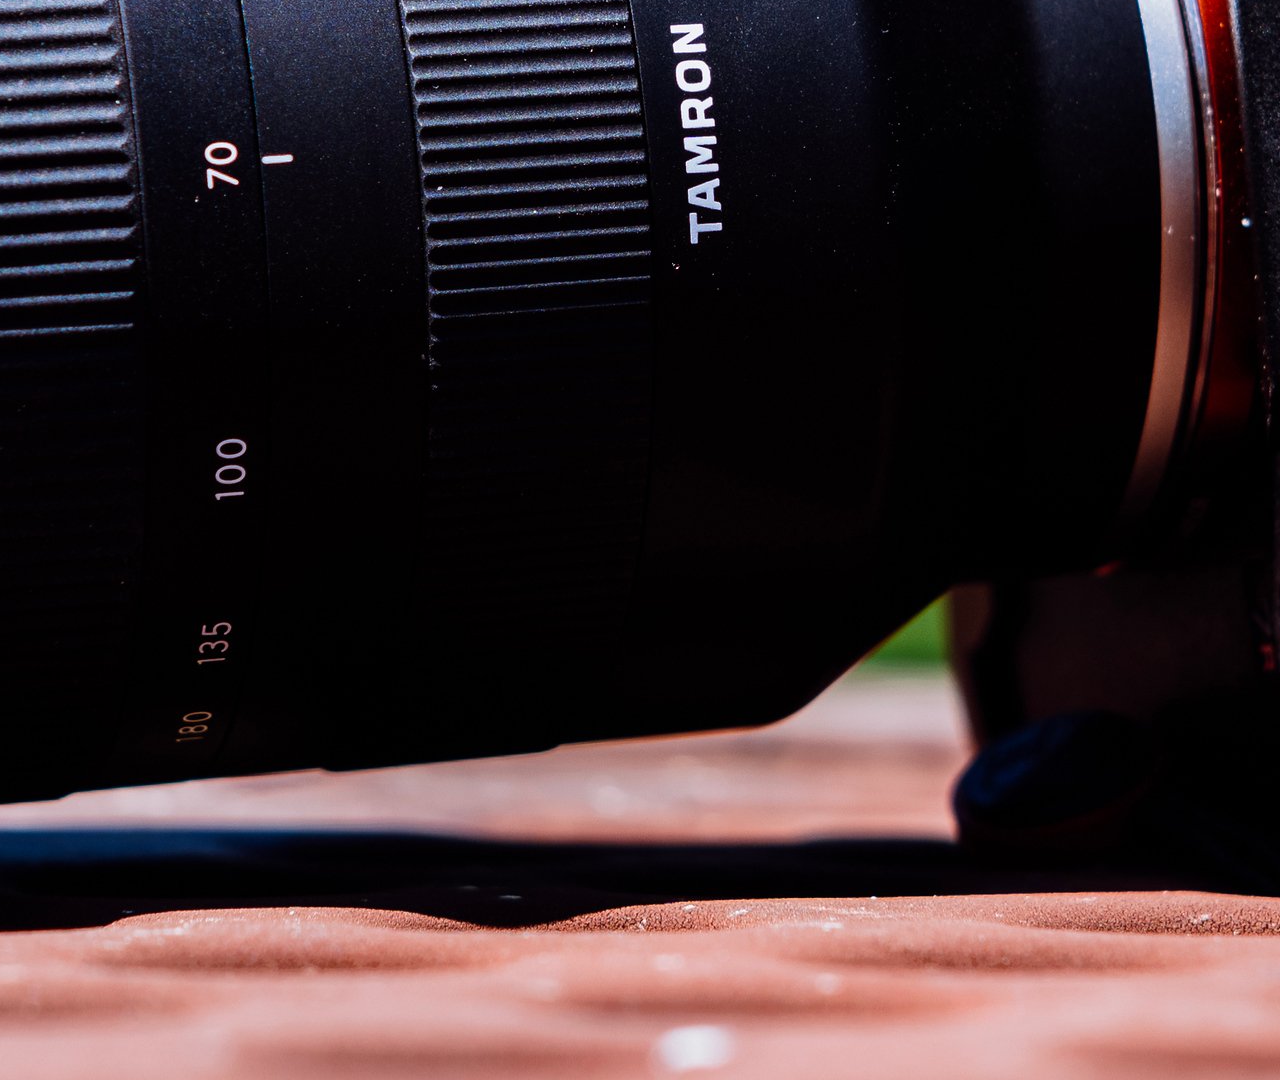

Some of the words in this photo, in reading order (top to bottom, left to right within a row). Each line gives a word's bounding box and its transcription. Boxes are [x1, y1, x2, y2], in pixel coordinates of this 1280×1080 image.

[669, 23, 723, 245] TAMRON
[204, 141, 240, 190] 70
[214, 438, 247, 501] 100
[196, 621, 232, 665] 135
[175, 709, 214, 743] 180
